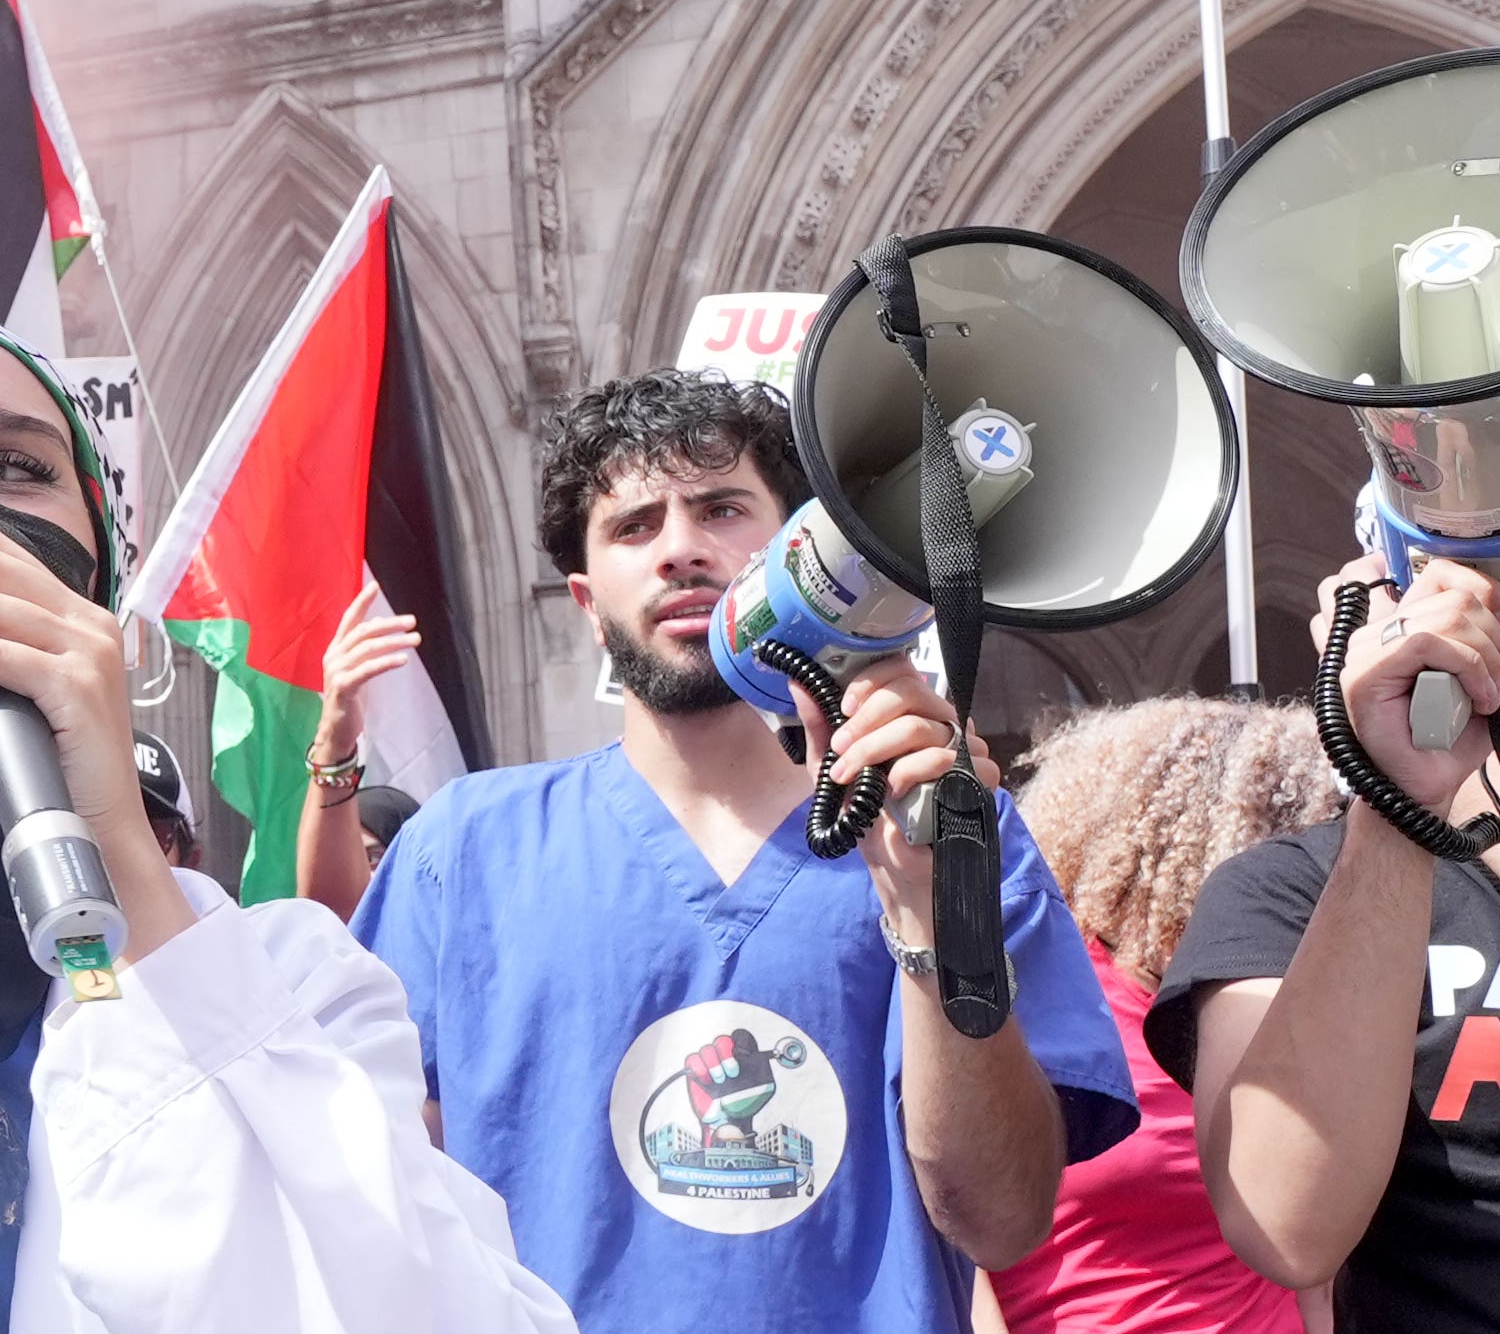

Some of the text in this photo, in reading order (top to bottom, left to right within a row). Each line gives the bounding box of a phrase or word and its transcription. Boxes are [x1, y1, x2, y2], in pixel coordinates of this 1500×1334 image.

[754, 359, 796, 383] #F
[686, 1185, 771, 1199] 4 PALESTINE
